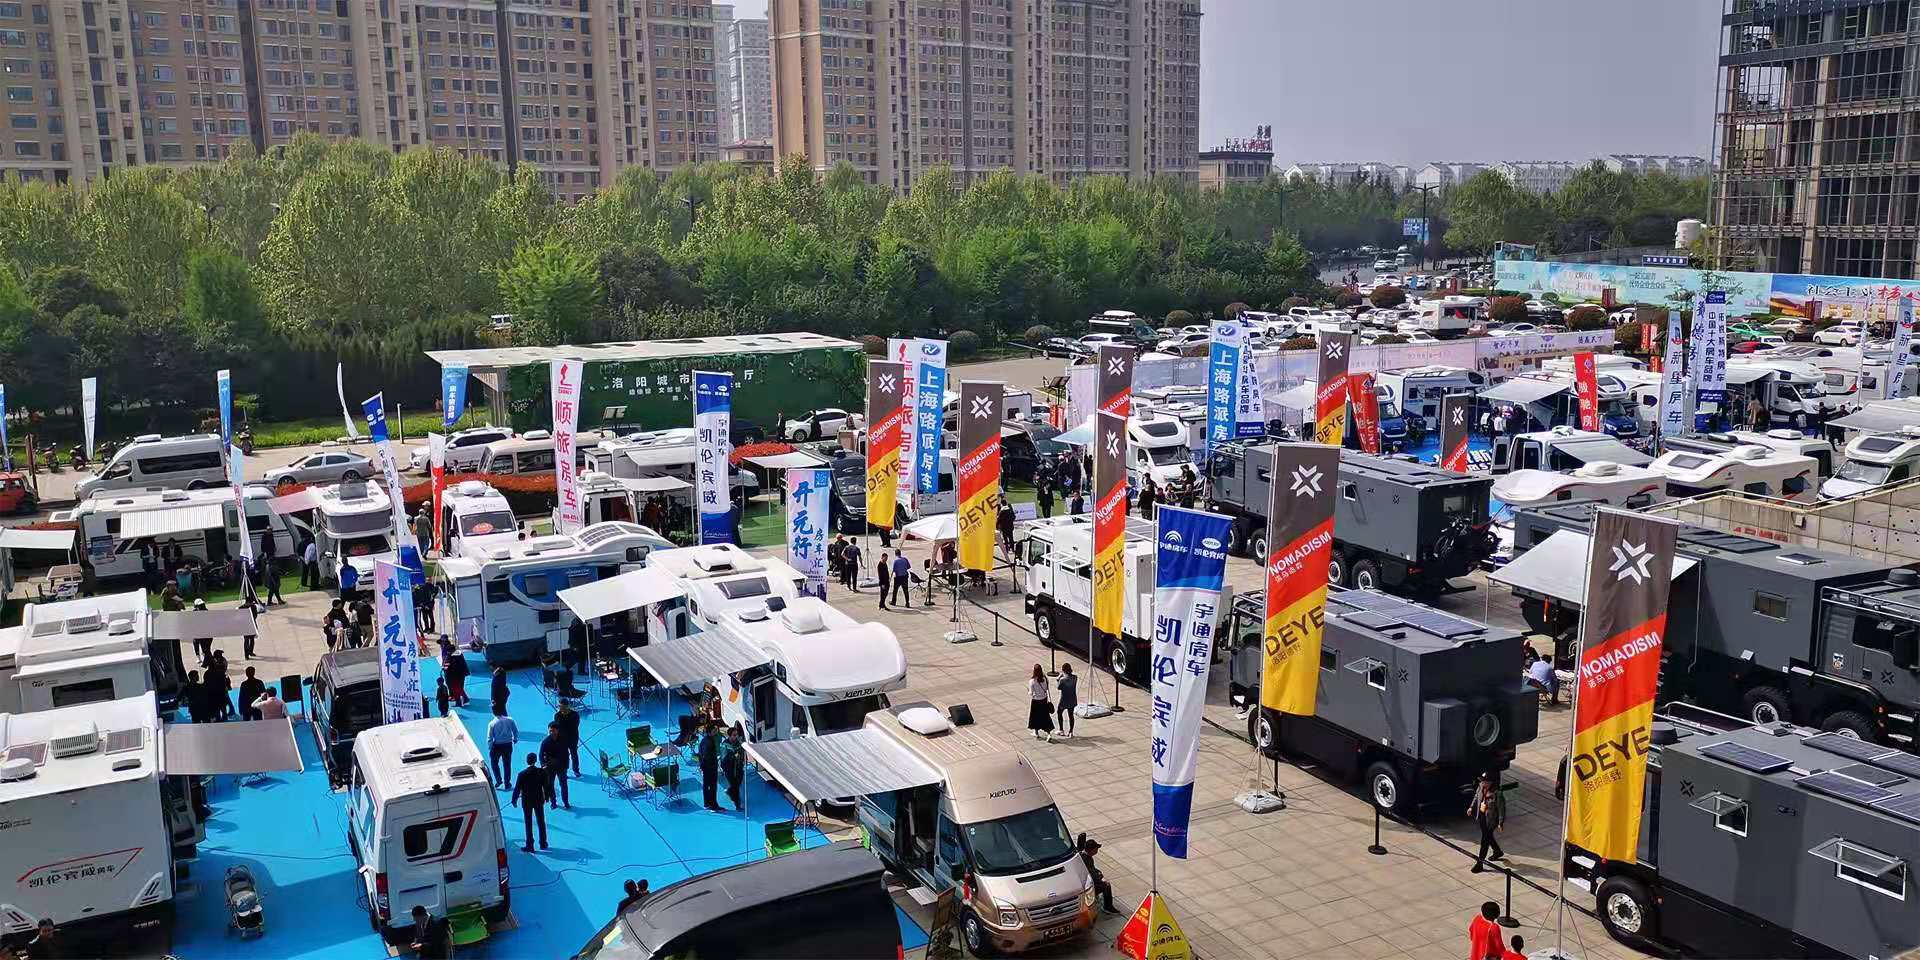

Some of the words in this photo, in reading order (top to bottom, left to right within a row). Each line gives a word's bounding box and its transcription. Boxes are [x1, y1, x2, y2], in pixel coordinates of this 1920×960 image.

[612, 369, 754, 389] 洛阳城市厅
[1667, 351, 1682, 424] 新星房车
[868, 412, 902, 441] NOMADISM
[920, 371, 939, 490] 上海路派房车
[1317, 414, 1345, 443] DEYE
[554, 400, 577, 511] 顺旅房车
[699, 428, 718, 504] 凯伦宾威
[868, 457, 900, 491] DEYE
[959, 442, 1000, 476] NOMADISM
[792, 481, 814, 559] 开元行
[959, 493, 999, 531] DEYE
[1094, 549, 1125, 586] DEYE
[1270, 531, 1332, 576] NOMADISM
[1186, 603, 1214, 677] 宇通房车
[1265, 605, 1325, 657] DEYE
[1581, 631, 1662, 678] NOMADISM
[1151, 614, 1182, 768] 凯伦宾威
[1573, 726, 1650, 781] DEYE
